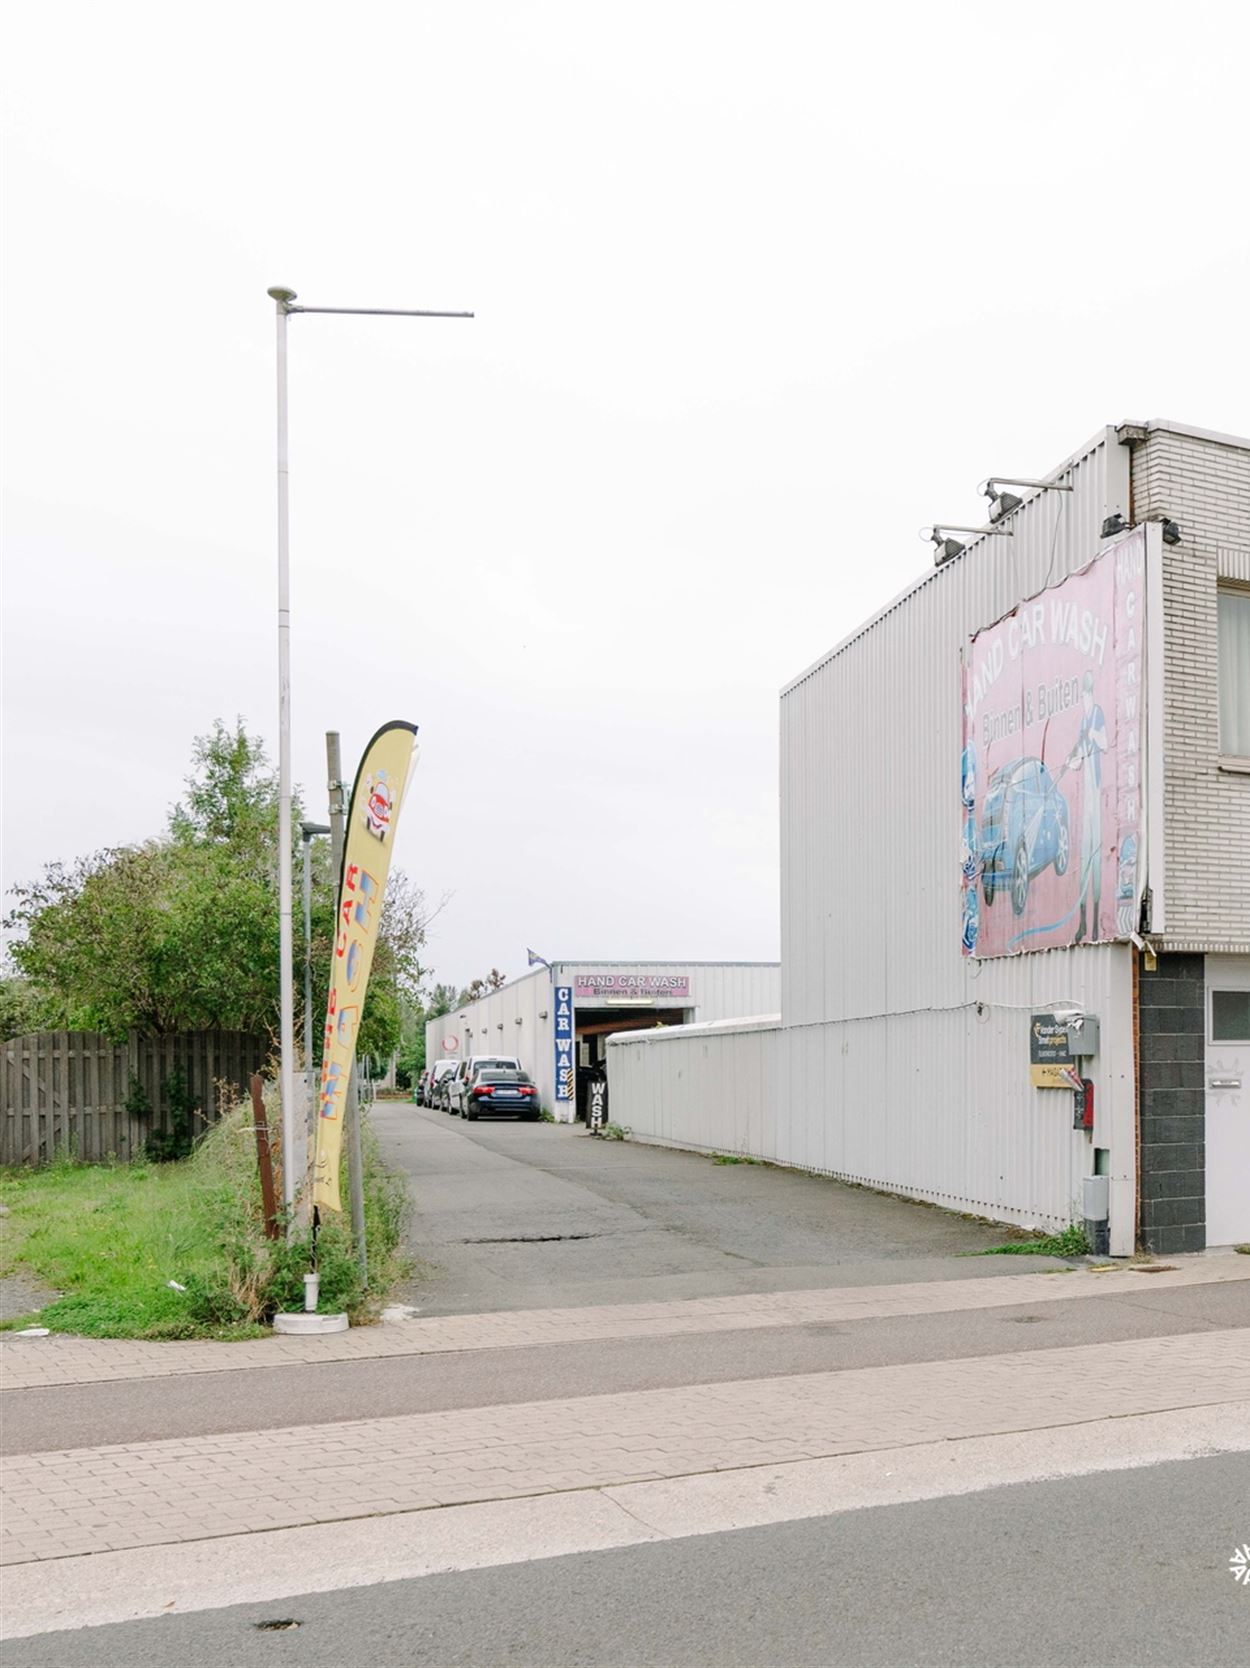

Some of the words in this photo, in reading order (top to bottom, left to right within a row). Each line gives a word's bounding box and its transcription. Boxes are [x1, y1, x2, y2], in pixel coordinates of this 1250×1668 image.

[964, 636, 1004, 720] HAND
[1007, 602, 1045, 661] CAR
[1051, 599, 1108, 667] WASH
[982, 704, 1021, 746] Binnen
[1025, 689, 1034, 726] &
[1037, 675, 1079, 721] Buiten
[336, 863, 359, 958] CAR
[578, 976, 615, 987] HAND
[618, 976, 646, 987] CAR
[650, 977, 687, 989] WASH
[593, 988, 628, 996] Binnen
[557, 988, 570, 1031] CAR
[591, 1082, 606, 1129] WASH
